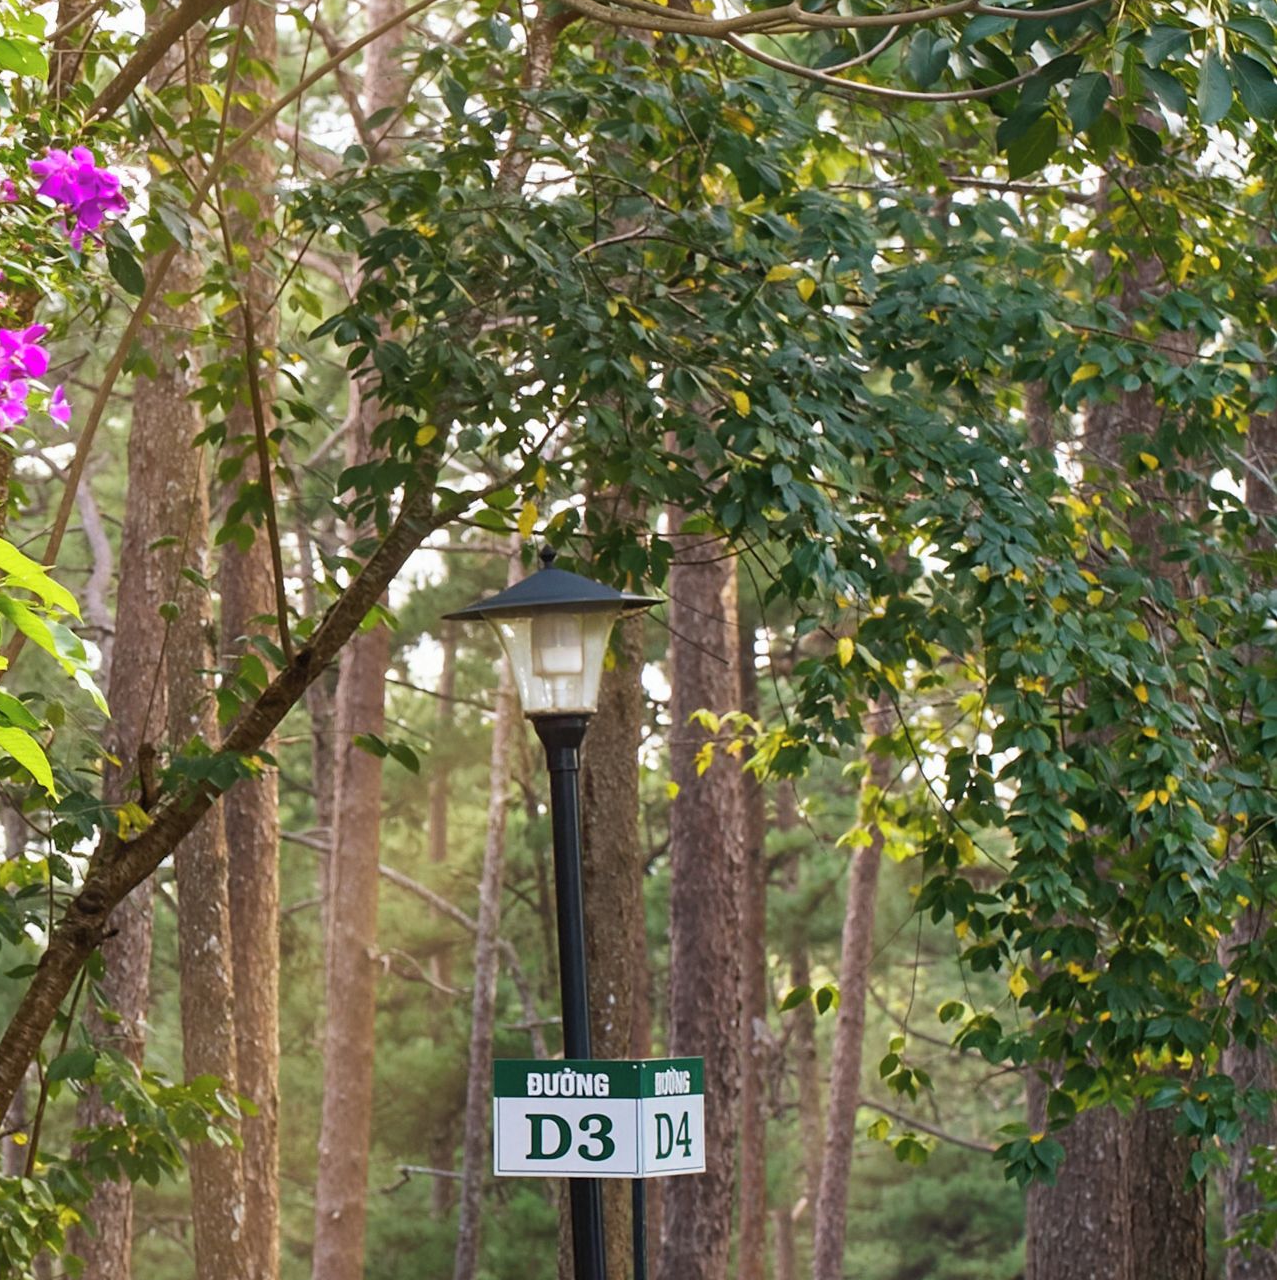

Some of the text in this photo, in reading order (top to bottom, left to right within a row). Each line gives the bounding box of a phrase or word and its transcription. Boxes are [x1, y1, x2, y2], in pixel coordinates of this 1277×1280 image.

[526, 1067, 610, 1097] ĐƯỜNG
[525, 1113, 616, 1162] D3
[654, 1111, 692, 1160] D4
